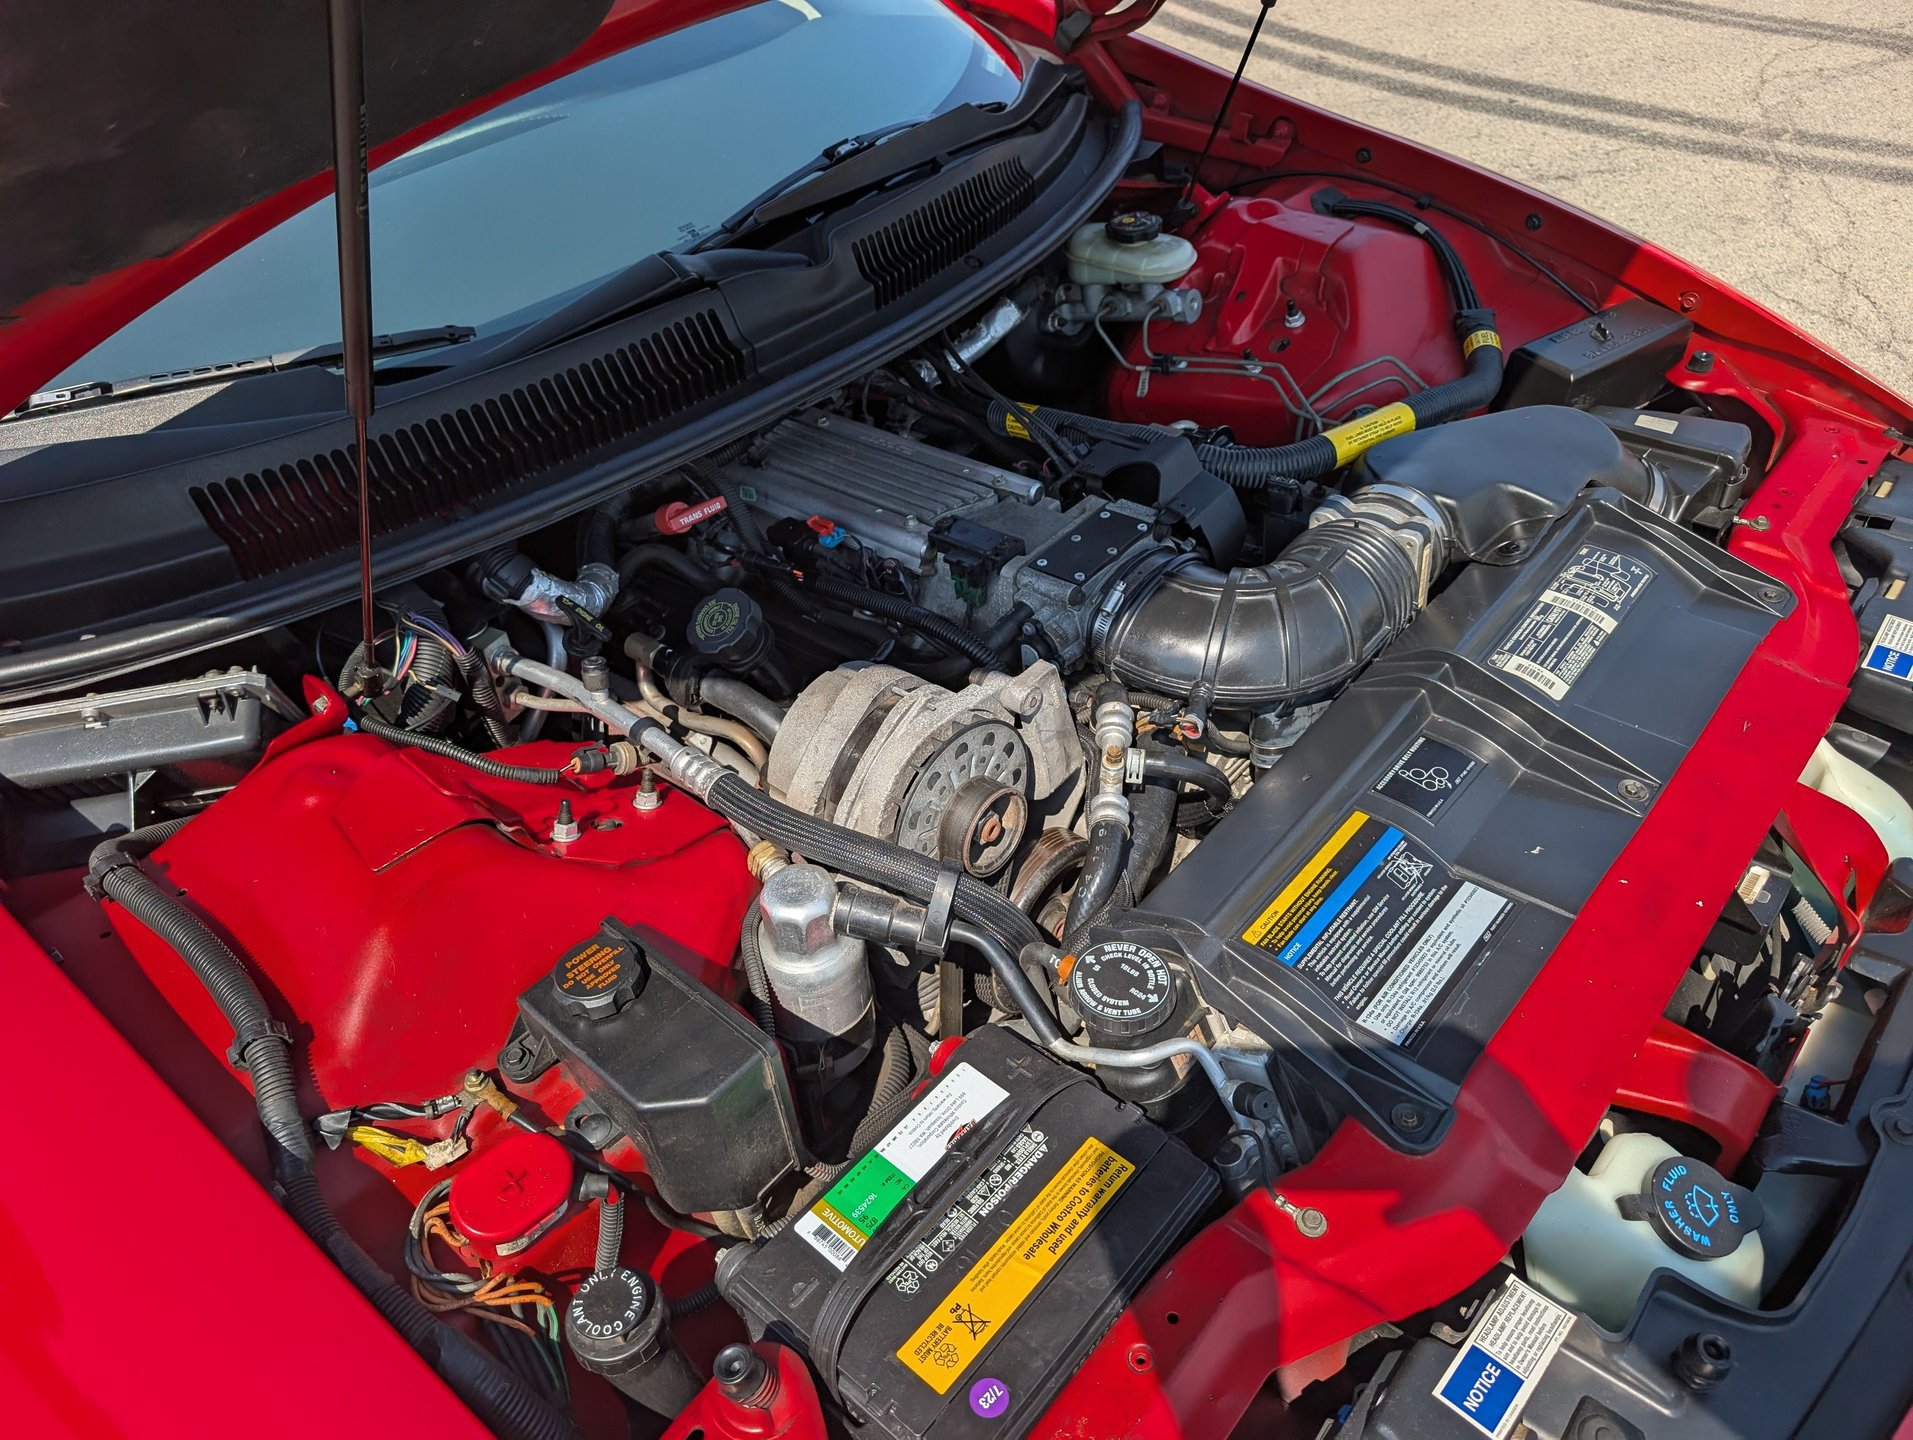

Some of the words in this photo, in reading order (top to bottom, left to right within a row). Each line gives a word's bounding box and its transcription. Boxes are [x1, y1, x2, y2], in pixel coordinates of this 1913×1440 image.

[679, 510, 703, 526] TRANS
[703, 502, 721, 515] FLUID
[575, 607, 593, 622] ENGINE
[595, 623, 604, 632] OIL
[1882, 650, 1900, 672] NOTICE
[1259, 909, 1279, 930] CAUTION
[1296, 938, 1324, 969] SUPPLEMENTAL
[1320, 918, 1342, 940] INFLATABLE
[1338, 897, 1359, 920] RESTRAINT.
[565, 943, 600, 969] POWER
[566, 945, 612, 979] STEERING
[1283, 941, 1302, 960] NOTICE
[562, 980, 574, 990] DO
[575, 969, 590, 981] NOT
[592, 945, 624, 969] OVERFILL
[581, 973, 596, 984] USE
[598, 960, 615, 973] ONLY
[586, 963, 621, 990] APPROVED
[1101, 953, 1122, 961] CHECK
[1124, 952, 1142, 963] LEVEL
[1147, 970, 1156, 990] BOTTLE
[1104, 944, 1136, 953] NEVER
[1138, 949, 1162, 968] OPEN
[1156, 968, 1167, 986] HOT
[1333, 990, 1344, 1001] THIS
[1340, 974, 1357, 992] VEHICLE
[1353, 955, 1372, 976] REQUIRES
[1371, 937, 1387, 954] SPECIAL
[598, 974, 618, 989] FLUID
[1087, 978, 1102, 998] CLOSED
[1101, 996, 1130, 1006] SYSTEM
[1361, 1008, 1375, 1023] R-134a
[1372, 997, 1384, 1010] (FOR
[1380, 990, 1389, 999] AIR
[1385, 963, 1410, 991] CONDITIONED
[1080, 989, 1098, 1008] ARROW
[1104, 1007, 1121, 1015] VENT
[1385, 1019, 1394, 1027] DO
[1391, 1010, 1401, 1020] NOT
[1397, 994, 1413, 1011] INSTALL
[1410, 986, 1419, 995] R12
[1415, 967, 1434, 988] refrigerant
[949, 1097, 960, 1107] Lake
[952, 1098, 967, 1112] Costco
[957, 1090, 966, 1099] 999
[923, 1114, 942, 1132] Issaquah,
[936, 1109, 956, 1129] Wholesale
[939, 1105, 952, 1117] Drive,
[915, 1126, 939, 1149] Corporation,
[918, 1130, 927, 1138] WA
[933, 1132, 942, 1140] by
[939, 1115, 959, 1135] Distributed
[907, 1136, 921, 1149] 98027
[1078, 1150, 1105, 1178] PROPOSITION
[1084, 1154, 1118, 1189] batteries
[1102, 1163, 1129, 1190] Return
[978, 1149, 1044, 1216] DANGER/POISON
[1074, 1176, 1082, 1184] 65
[1077, 1185, 1090, 1197] to
[1662, 1164, 1688, 1192] FLUID
[849, 1191, 878, 1219] 1624539
[1056, 1181, 1077, 1203] WARNING:
[1073, 1185, 1108, 1221] warranty
[857, 1213, 869, 1224] 95
[1054, 1194, 1083, 1223] Costco
[1720, 1190, 1740, 1224] ONLY
[821, 1206, 866, 1248] UTOMOTIVE
[864, 1215, 878, 1230] 875
[1063, 1217, 1082, 1236] and
[1665, 1199, 1712, 1248] WASHER
[1021, 1219, 1061, 1262] Wholesale
[1047, 1232, 1069, 1255] used
[620, 1270, 643, 1321] ENGINE
[948, 1301, 962, 1315] Pb
[572, 1299, 623, 1336] COOLANT
[934, 1321, 944, 1332] BE
[1478, 1314, 1499, 1343] HEADLAMP
[1495, 1283, 1520, 1316] ADJUSTMENT
[1487, 1321, 1508, 1347] HEADLAMP
[1503, 1290, 1527, 1323] REPLACEMENT
[1498, 1340, 1508, 1351] help
[1505, 1328, 1516, 1342] ensure
[1513, 1315, 1524, 1330] proper
[1520, 1297, 1535, 1317] headlamp
[912, 1328, 938, 1357] RECYCLED
[930, 1324, 952, 1349] BATTERY
[1502, 1351, 1510, 1360] aim
[1506, 1344, 1514, 1353] and
[1514, 1330, 1523, 1341] help
[1519, 1320, 1530, 1332] avoid
[1526, 1305, 1540, 1322] damage
[1508, 1345, 1523, 1365] headlamp
[1520, 1334, 1531, 1347] parts,
[1527, 1324, 1536, 1335] read
[1532, 1304, 1549, 1326] instructions
[1517, 1348, 1530, 1365] Owner's
[1526, 1334, 1539, 1350] Manual
[1535, 1321, 1547, 1335] before
[1521, 1355, 1536, 1375] adjusting
[1535, 1333, 1550, 1353] replacing
[1545, 1312, 1563, 1335] headlamps.
[917, 1346, 933, 1364] MUST
[979, 1385, 1003, 1409] 7/23
[1462, 1361, 1502, 1413] NOTICE
